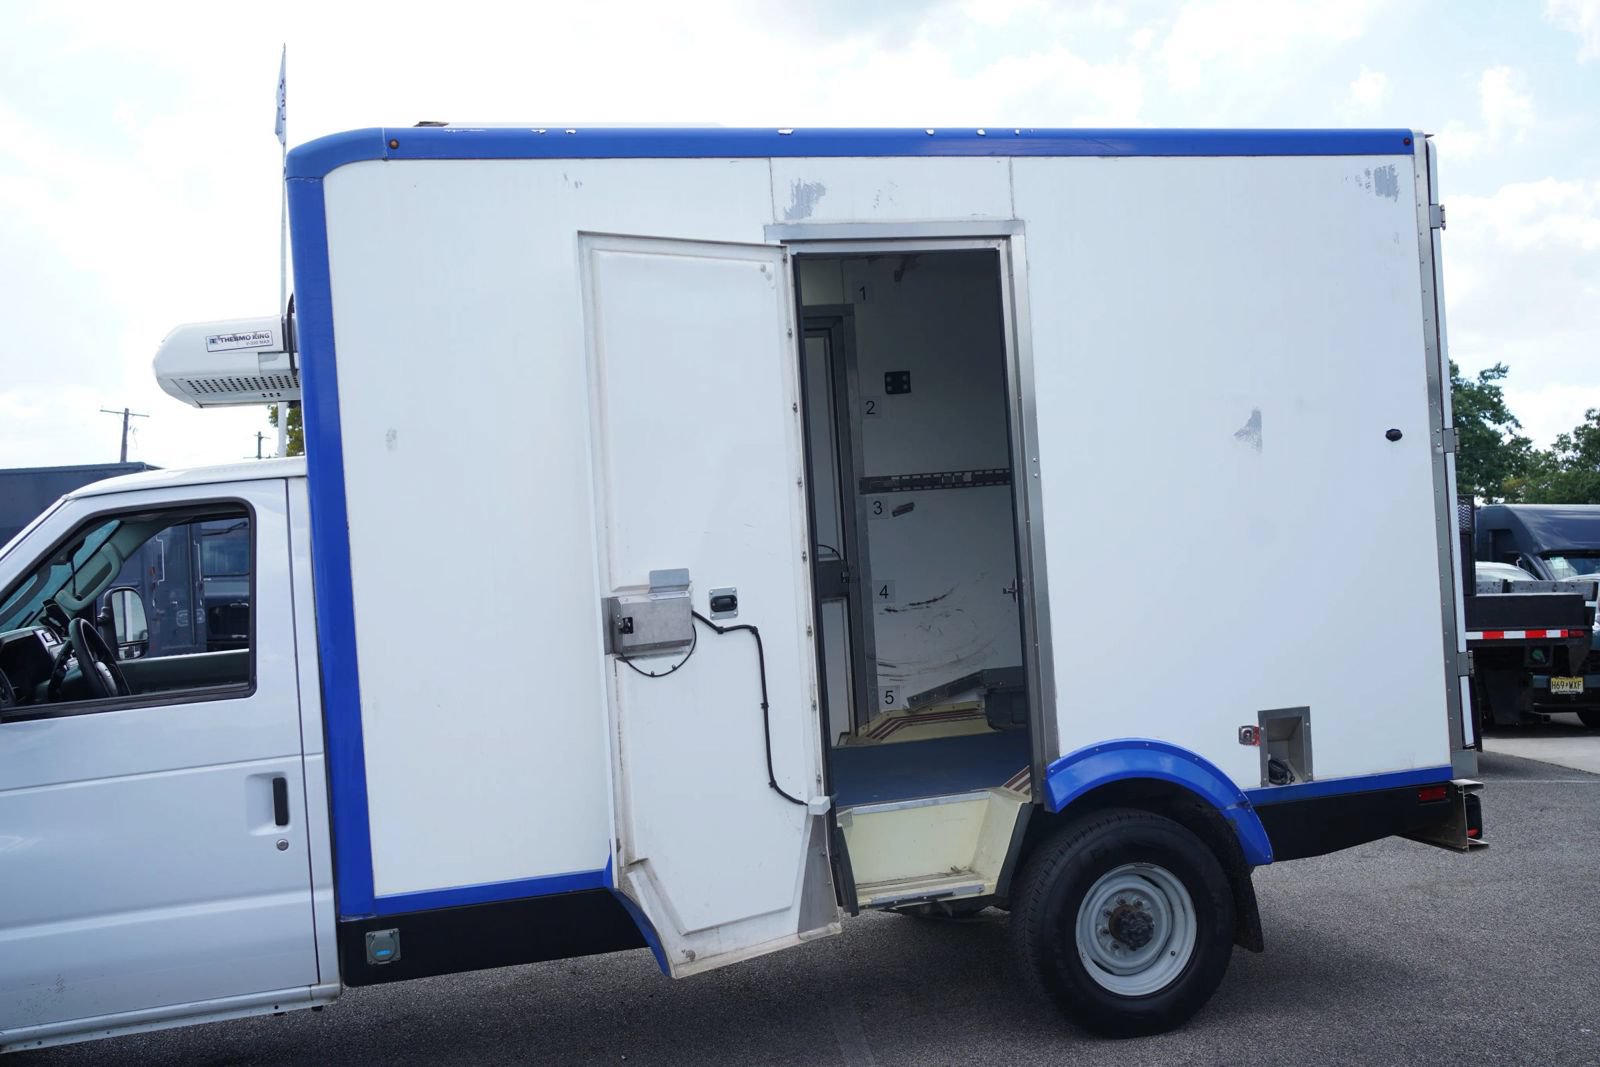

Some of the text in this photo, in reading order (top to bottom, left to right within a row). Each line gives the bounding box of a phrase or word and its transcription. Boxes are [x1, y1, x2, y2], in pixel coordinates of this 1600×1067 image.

[859, 286, 866, 300] 1
[220, 335, 251, 343] THERMO
[252, 332, 270, 340] KING
[865, 400, 876, 415] 2
[873, 500, 883, 516] 3
[879, 584, 889, 599] 4
[884, 690, 895, 705] 5
